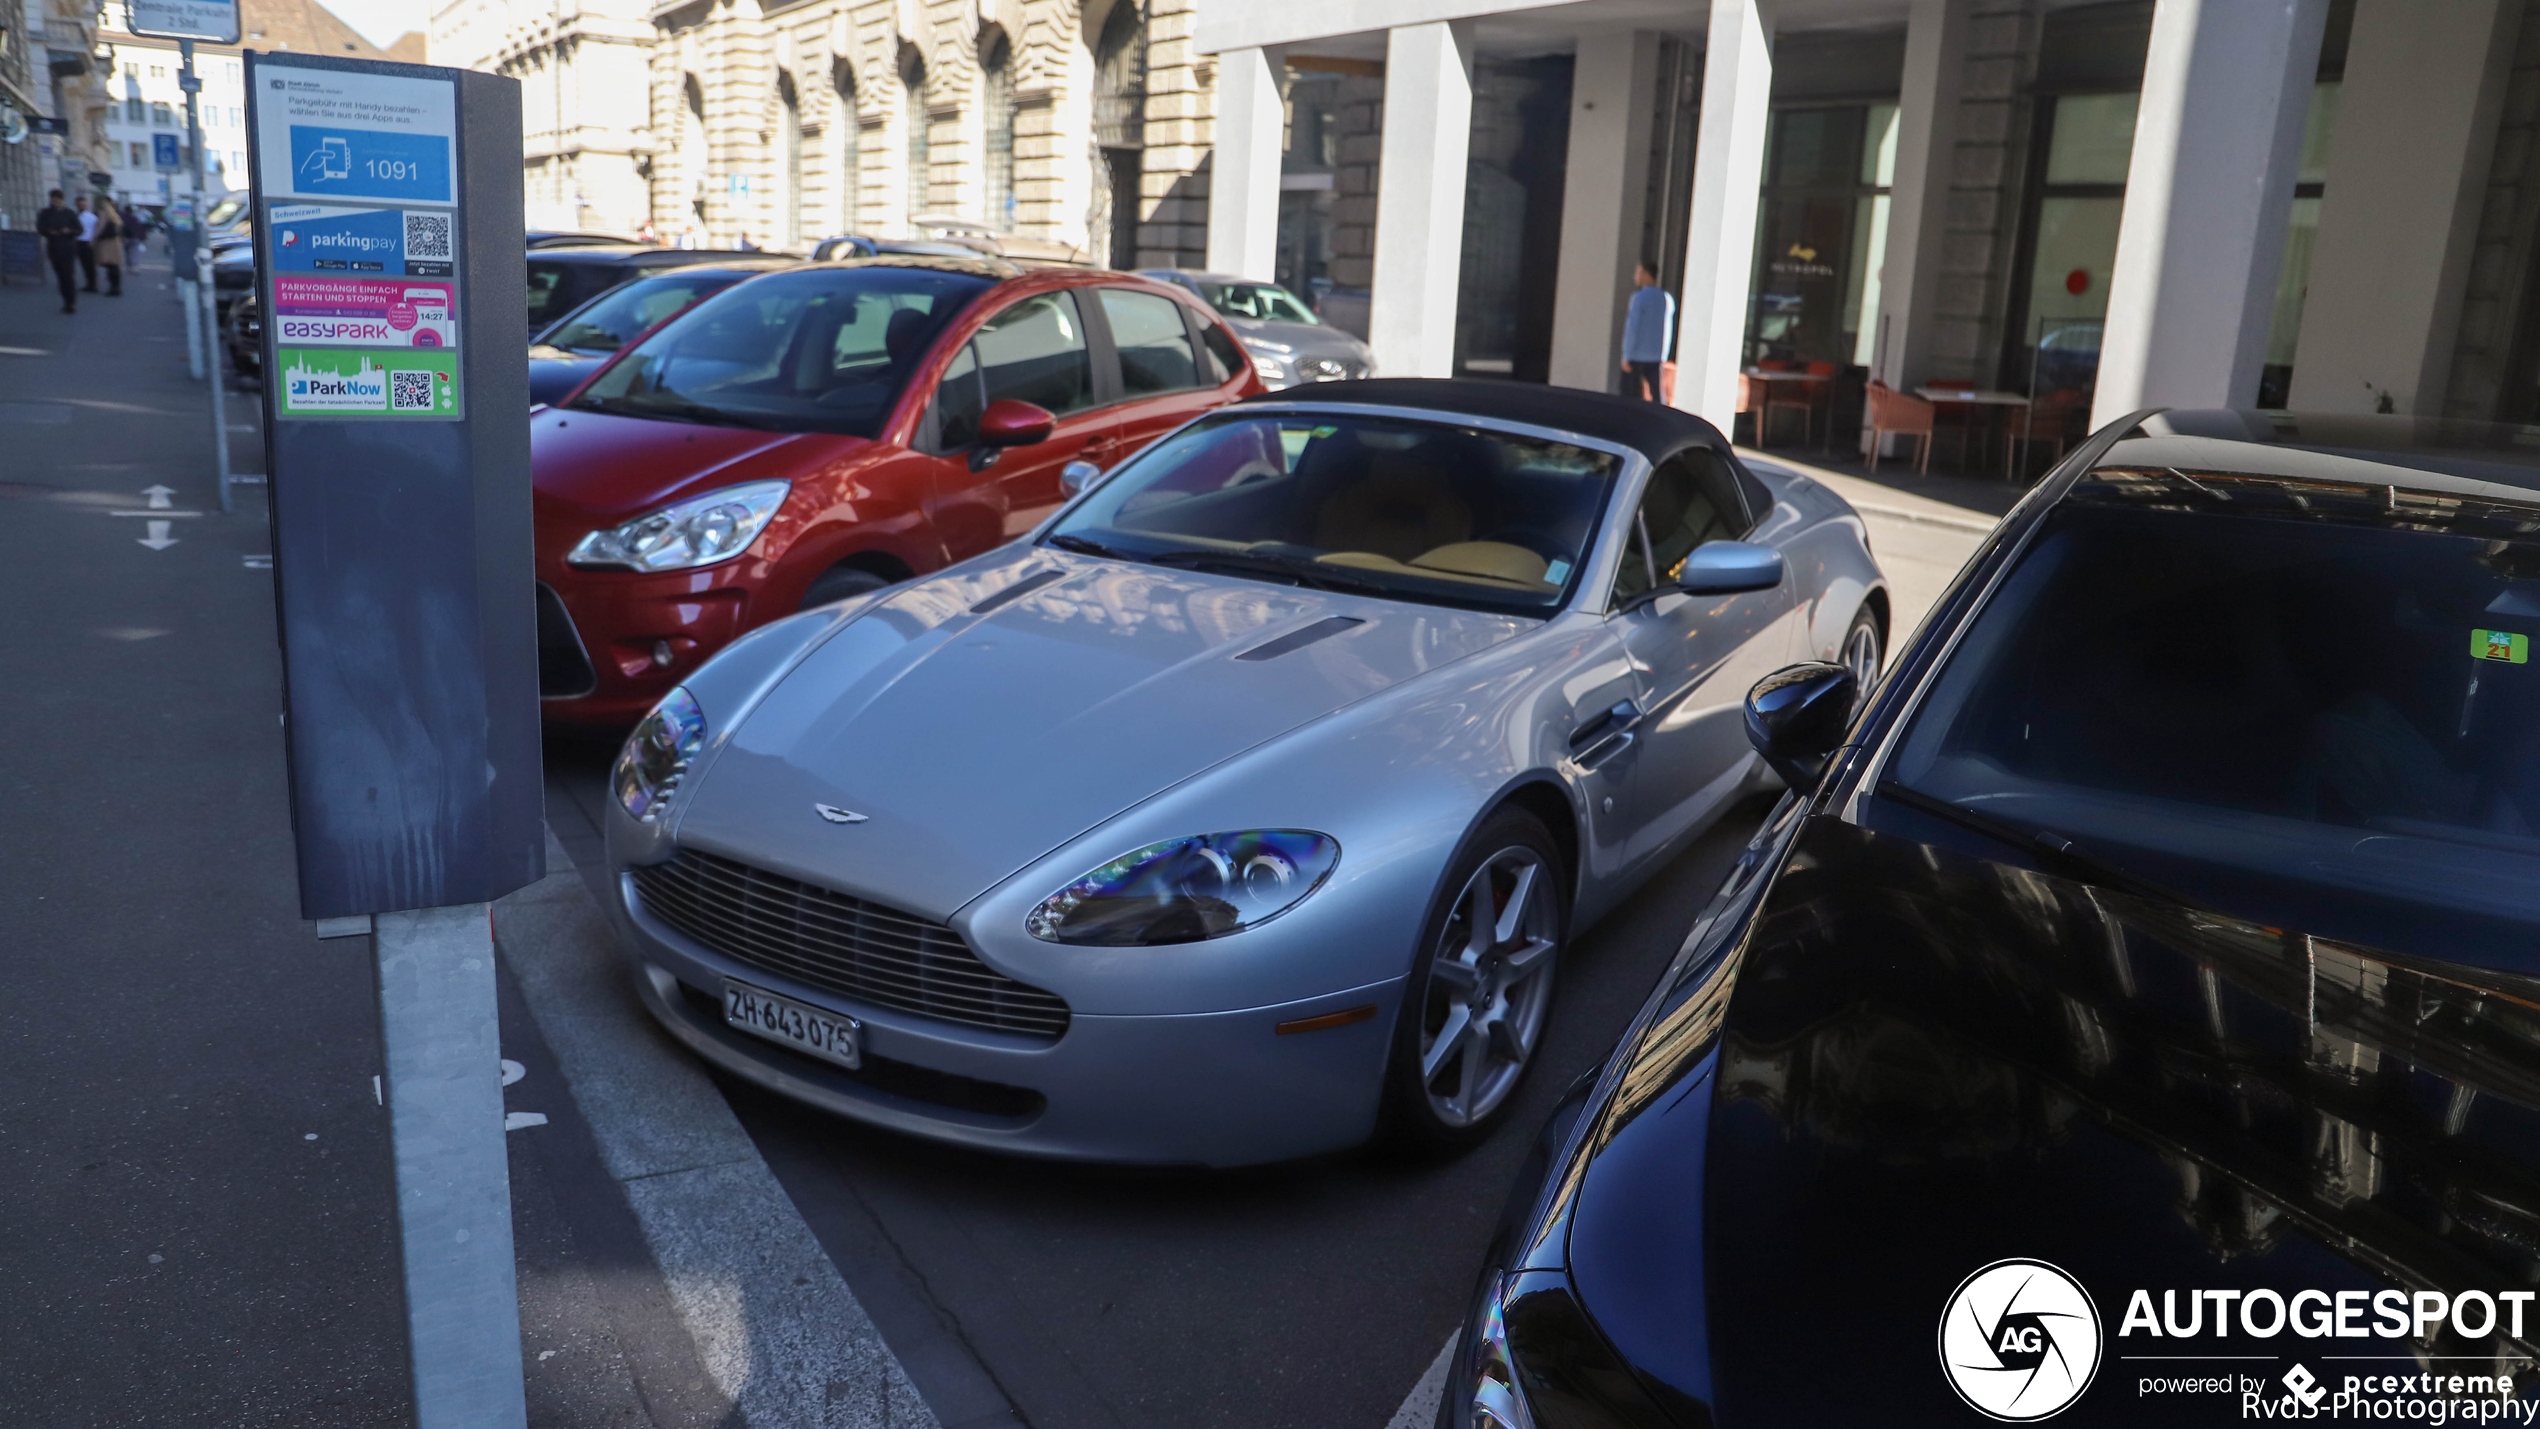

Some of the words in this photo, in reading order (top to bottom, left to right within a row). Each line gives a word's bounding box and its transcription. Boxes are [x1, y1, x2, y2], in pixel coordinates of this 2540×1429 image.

[288, 96, 337, 107] Parkgebühr
[340, 101, 352, 109] mit
[355, 102, 382, 113] Handy
[384, 104, 420, 114] bezahlen
[289, 107, 319, 116] wählen
[321, 109, 335, 117] Sie
[354, 112, 370, 121] drei
[372, 114, 393, 123] Apps
[366, 159, 418, 181] 1091
[275, 207, 321, 218] Schweizweit
[312, 230, 397, 252] parkingpay
[281, 283, 357, 293] PARKVORGÄNGE
[359, 286, 398, 294] EINFACH
[282, 292, 322, 301] STARTEN
[324, 294, 345, 302] UND
[346, 295, 387, 303] STOPPEN
[420, 312, 443, 321] 14:27
[310, 381, 380, 396] ParkNow
[2487, 643, 2511, 658] 21
